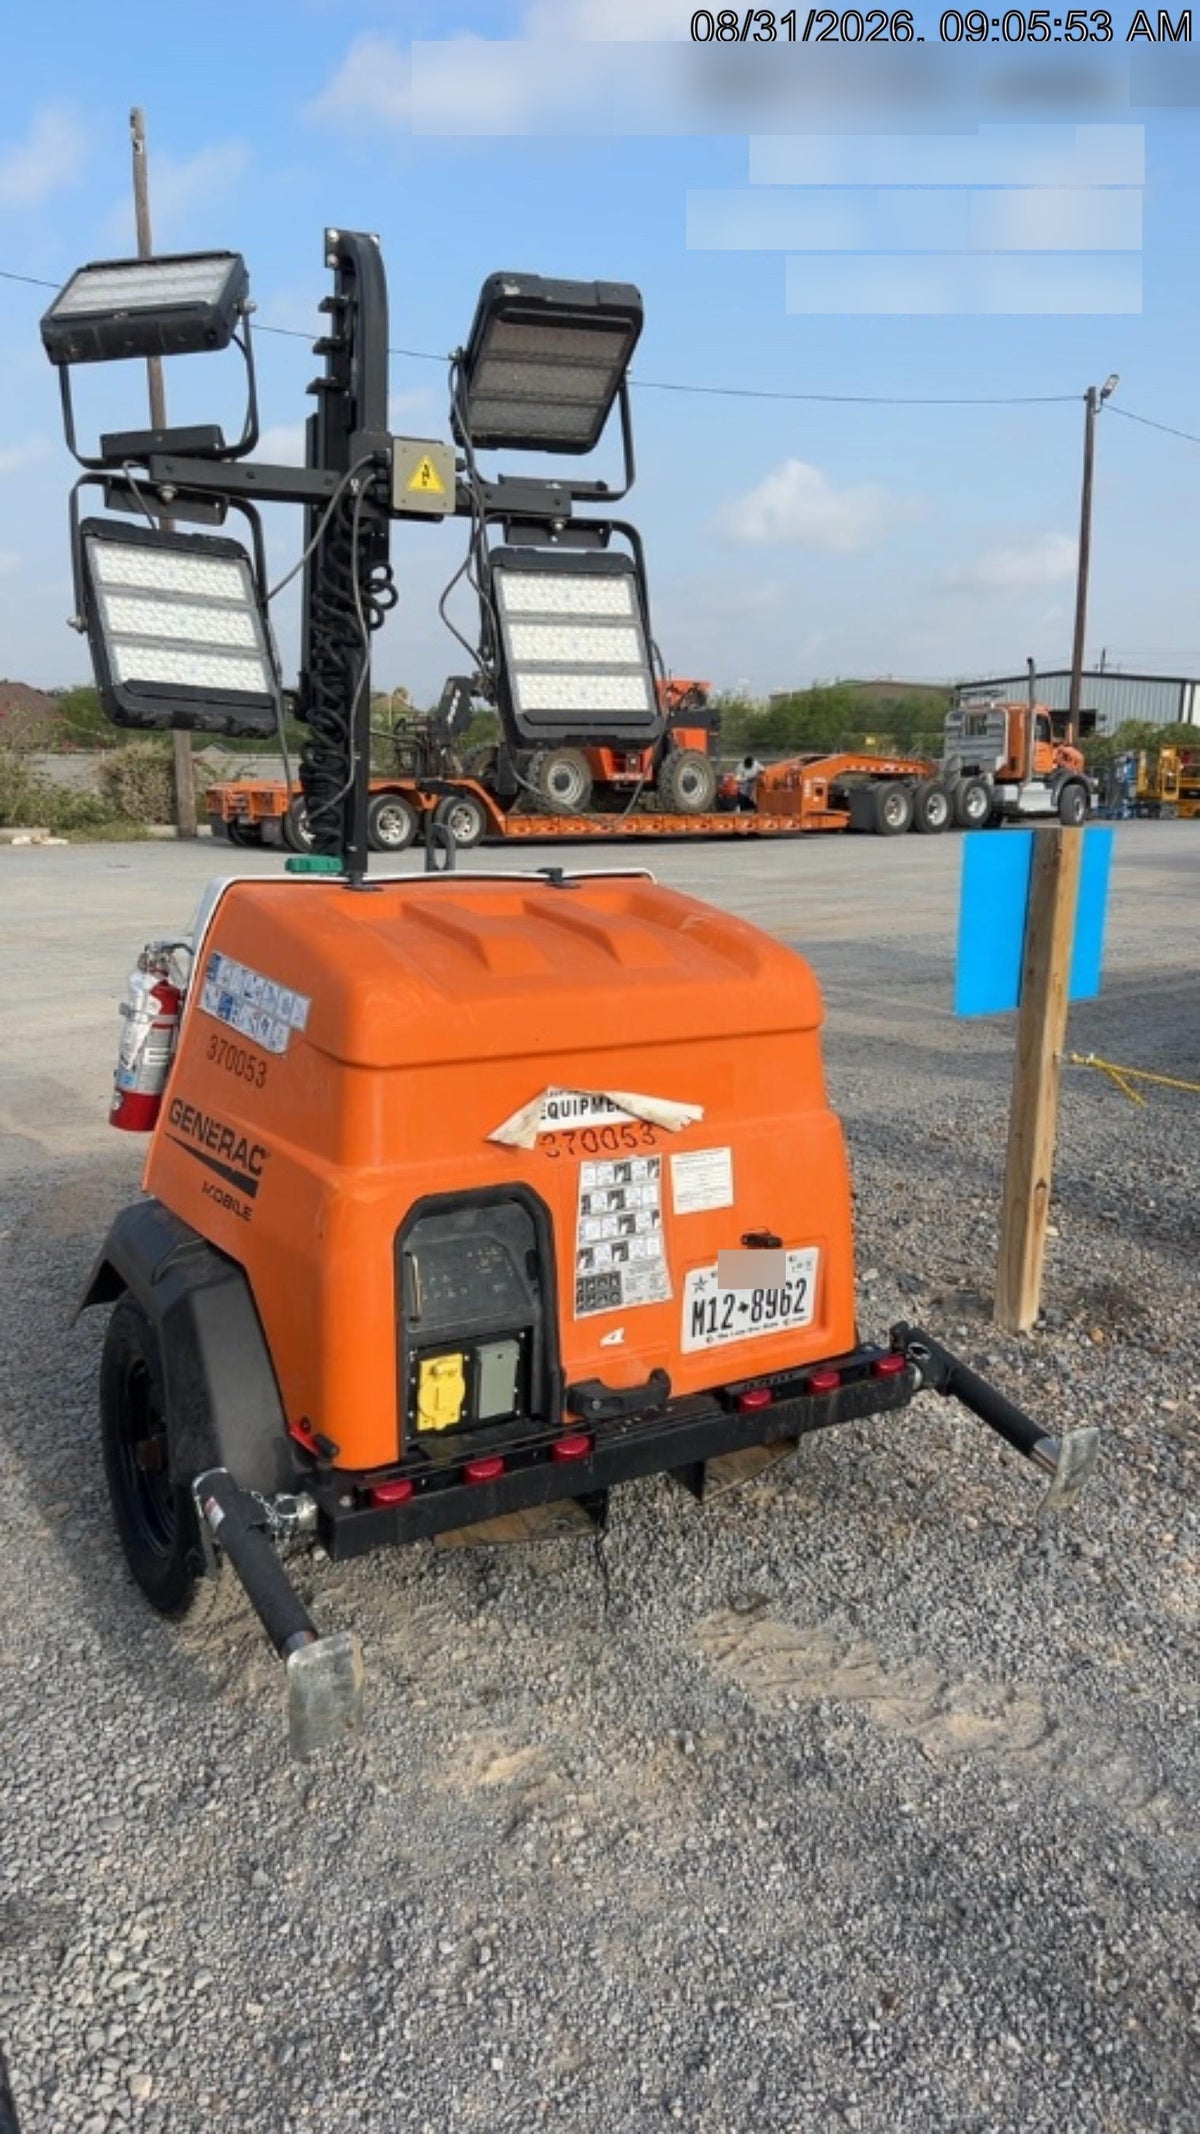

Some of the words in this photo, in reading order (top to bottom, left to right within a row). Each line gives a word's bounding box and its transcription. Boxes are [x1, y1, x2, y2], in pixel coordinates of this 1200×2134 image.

[206, 1034, 268, 1089] 370053
[168, 1097, 268, 1176] GENERAC
[542, 1122, 657, 1158] 370053
